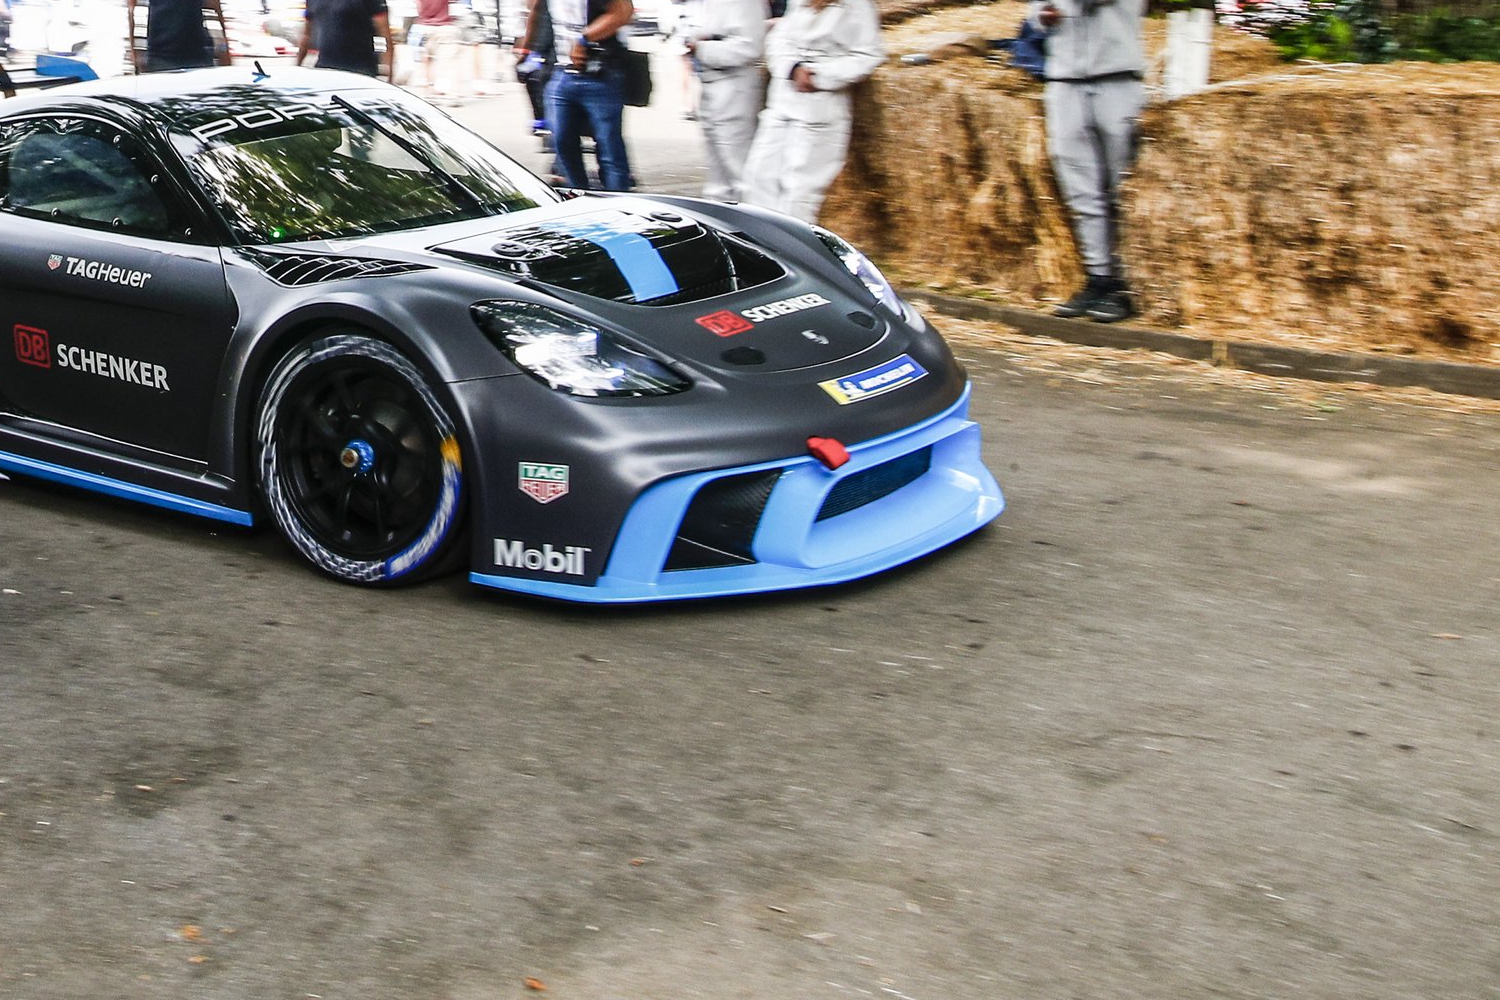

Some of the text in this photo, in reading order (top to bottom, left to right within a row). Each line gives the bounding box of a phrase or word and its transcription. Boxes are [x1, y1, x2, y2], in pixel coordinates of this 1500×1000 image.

[700, 293, 831, 335] DB SCHENKER
[17, 328, 170, 391] DB SCHENKER
[523, 465, 565, 480] TAG
[493, 538, 586, 576] Mobil
